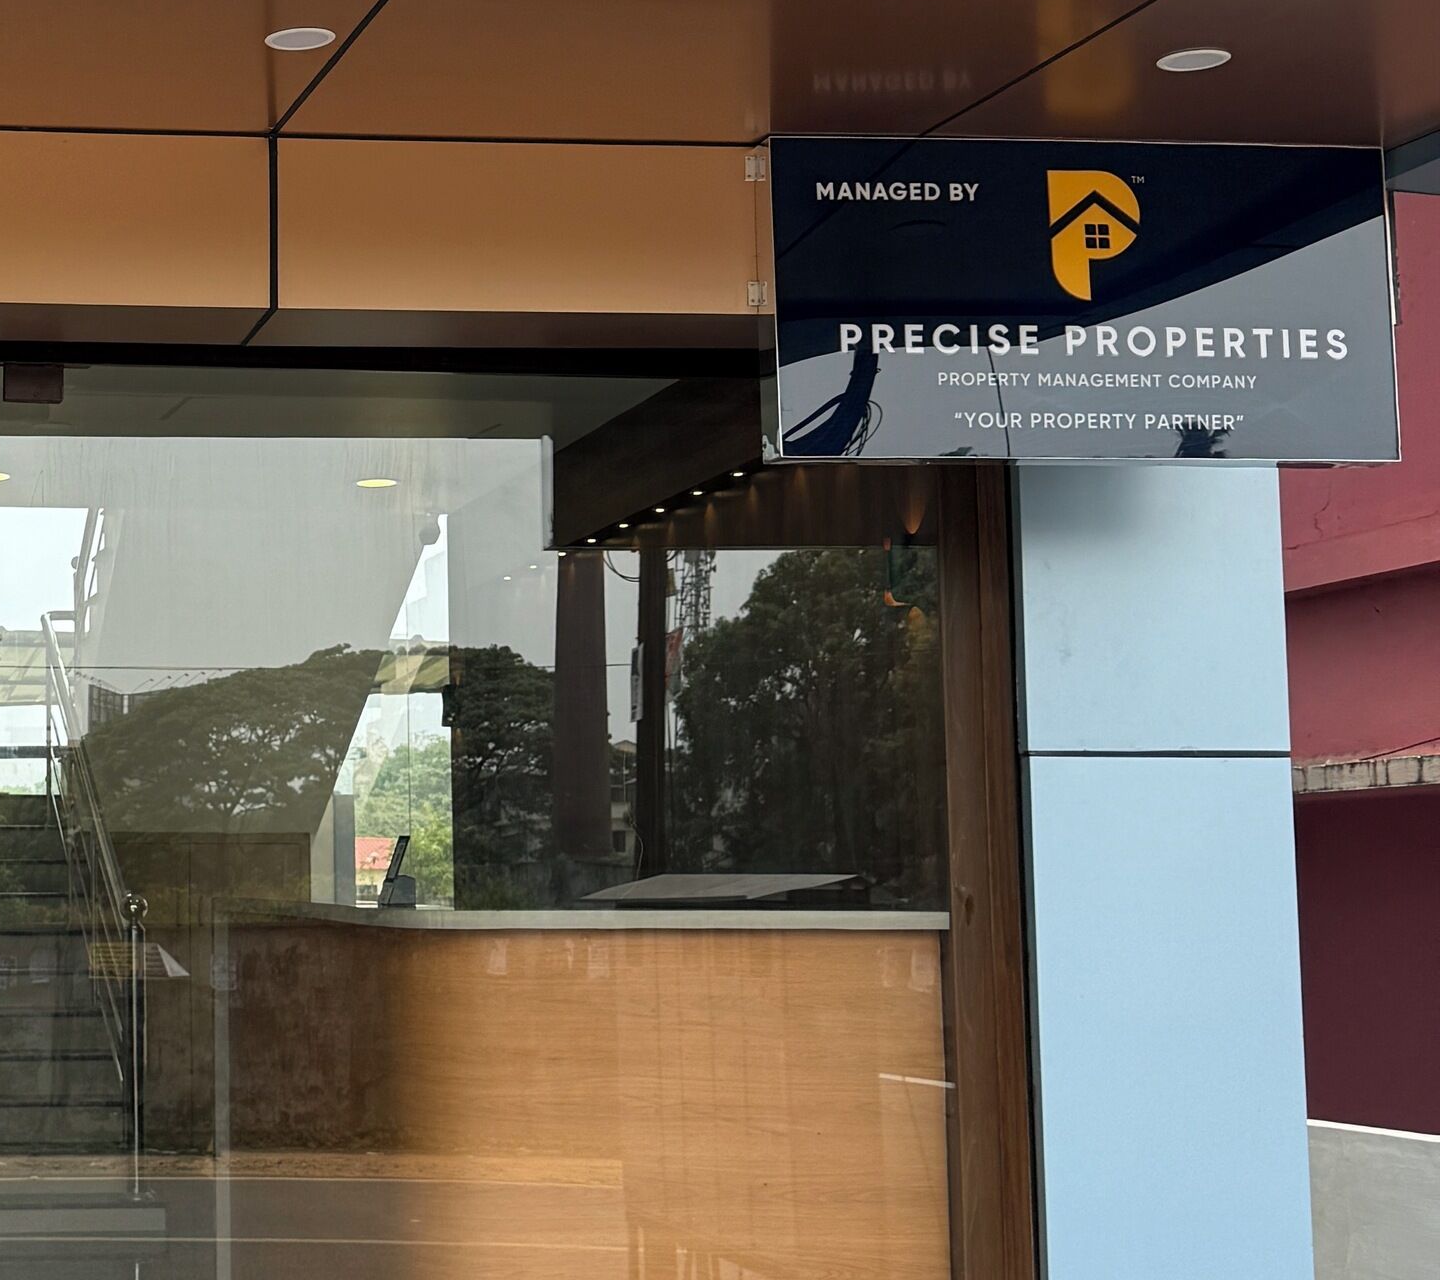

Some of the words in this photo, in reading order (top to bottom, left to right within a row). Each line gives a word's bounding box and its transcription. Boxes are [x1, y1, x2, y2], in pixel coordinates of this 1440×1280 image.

[815, 181, 942, 202] MANAGED
[949, 182, 980, 203] BY
[839, 322, 1041, 357] PRECISE
[1064, 324, 1349, 360] PROPERTIES
[937, 371, 1031, 387] PROPERTY
[1037, 372, 1163, 388] MANAGEMENT
[1167, 373, 1257, 389] COMPANY
[1030, 412, 1137, 430] PROPERTY
